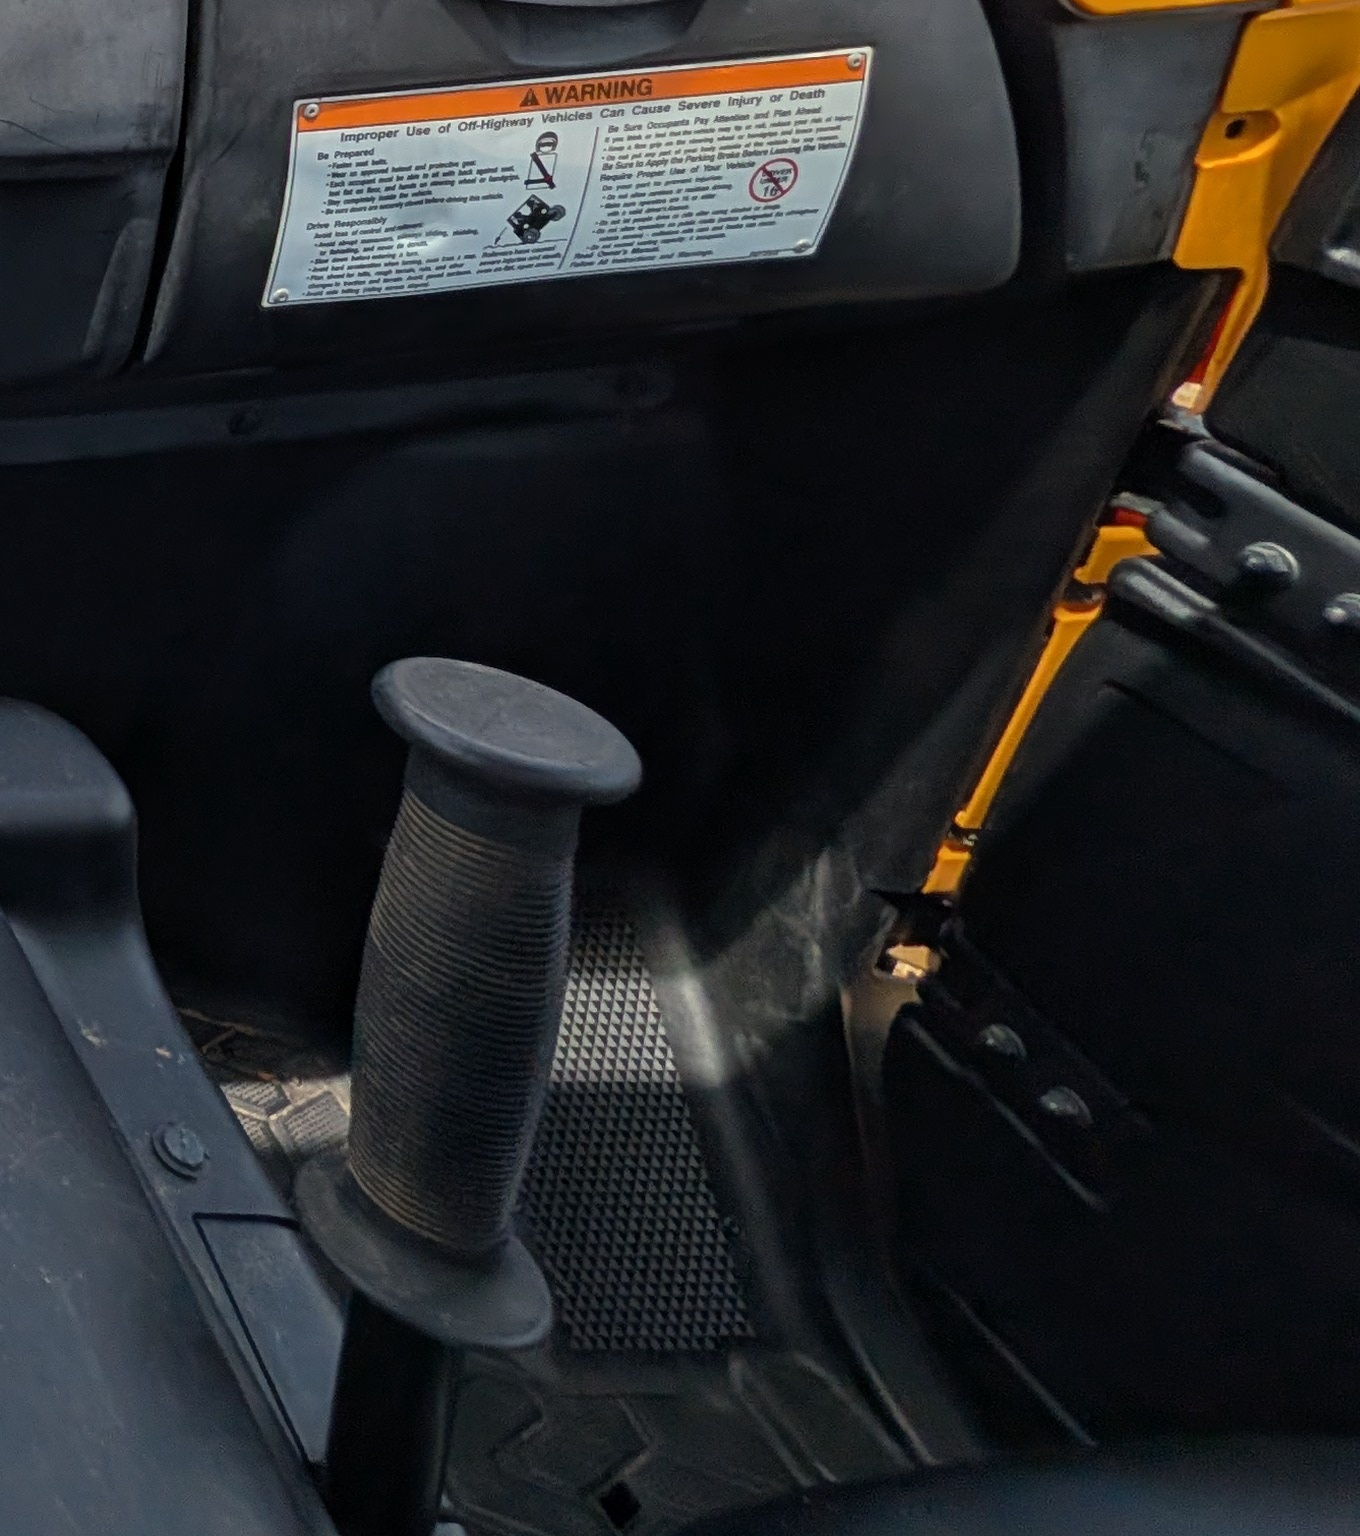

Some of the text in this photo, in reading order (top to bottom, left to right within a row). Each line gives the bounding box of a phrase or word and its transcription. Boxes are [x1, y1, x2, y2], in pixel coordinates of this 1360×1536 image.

[543, 78, 653, 104] WARNING
[339, 88, 825, 144] Improper Use of Off-Highway Vehicles Can Cause Severe Injury or Death
